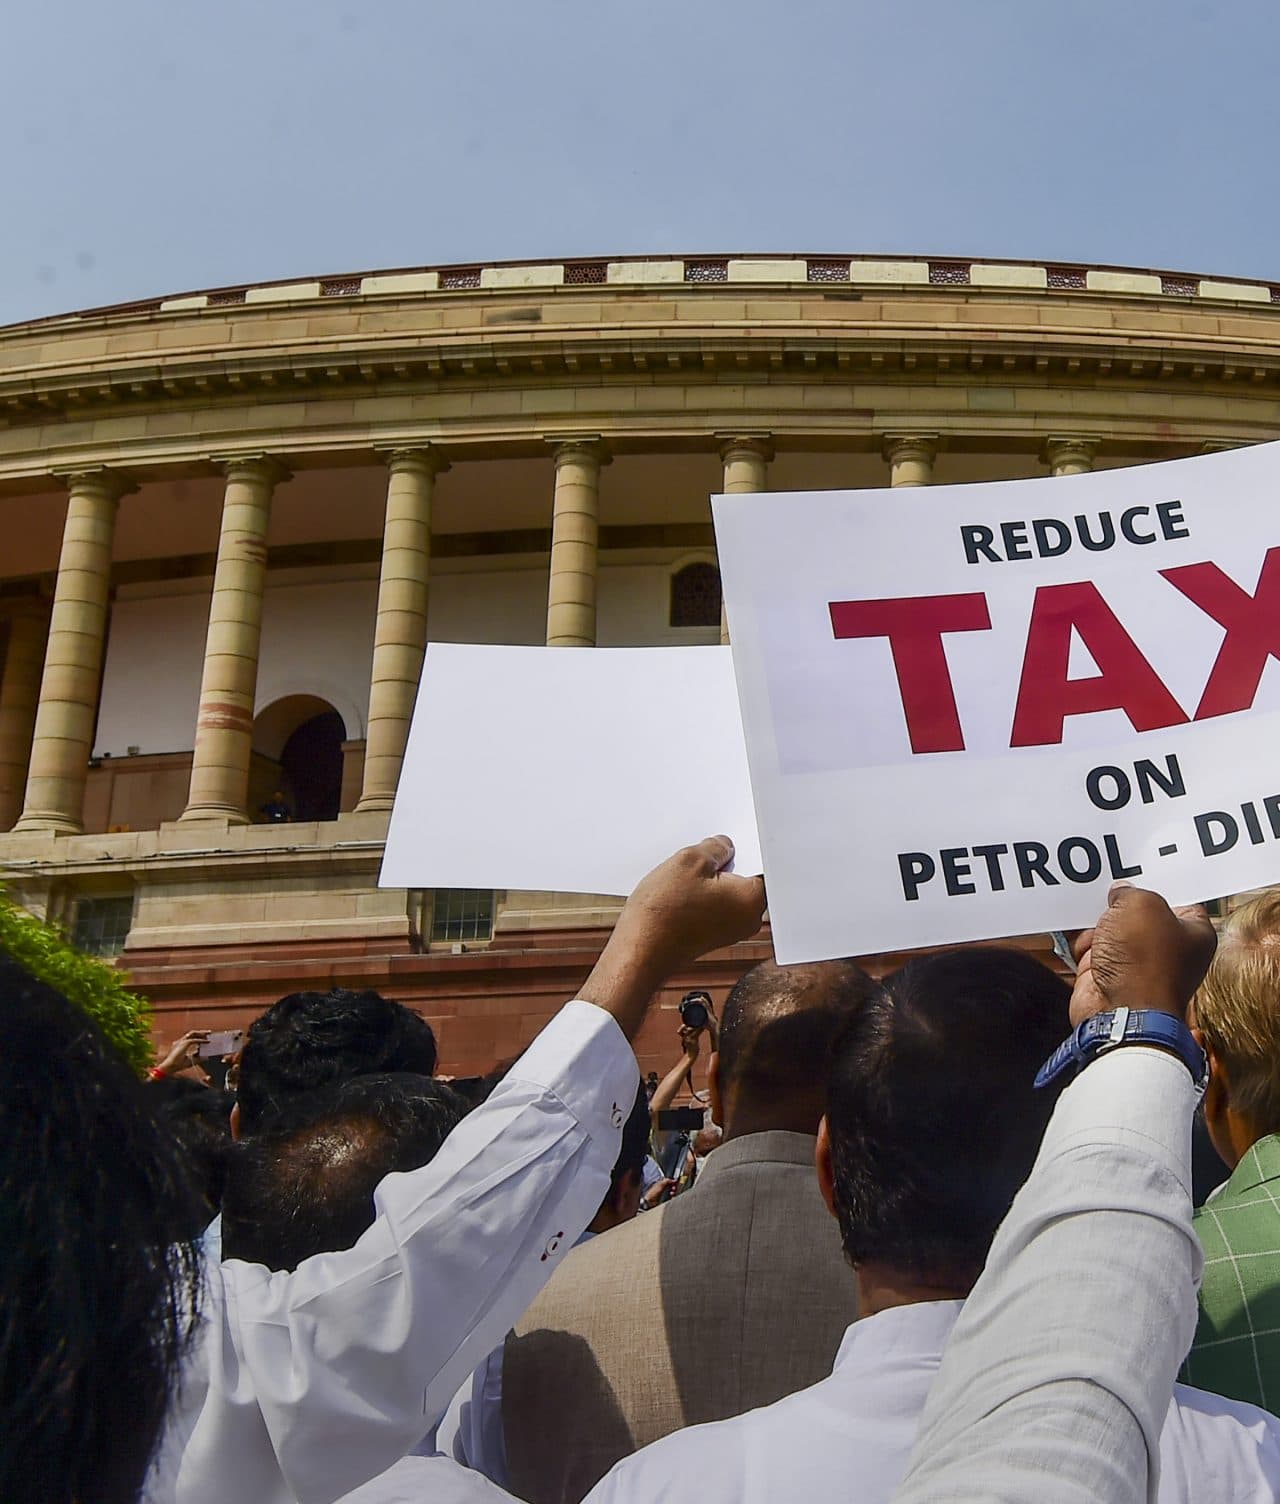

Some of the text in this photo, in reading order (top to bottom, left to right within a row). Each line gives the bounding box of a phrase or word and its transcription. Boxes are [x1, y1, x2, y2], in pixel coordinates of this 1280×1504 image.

[959, 500, 1190, 565] REDUCE
[1085, 753, 1187, 811] ON
[897, 833, 1143, 902] PETROL
[1158, 842, 1178, 857] -
